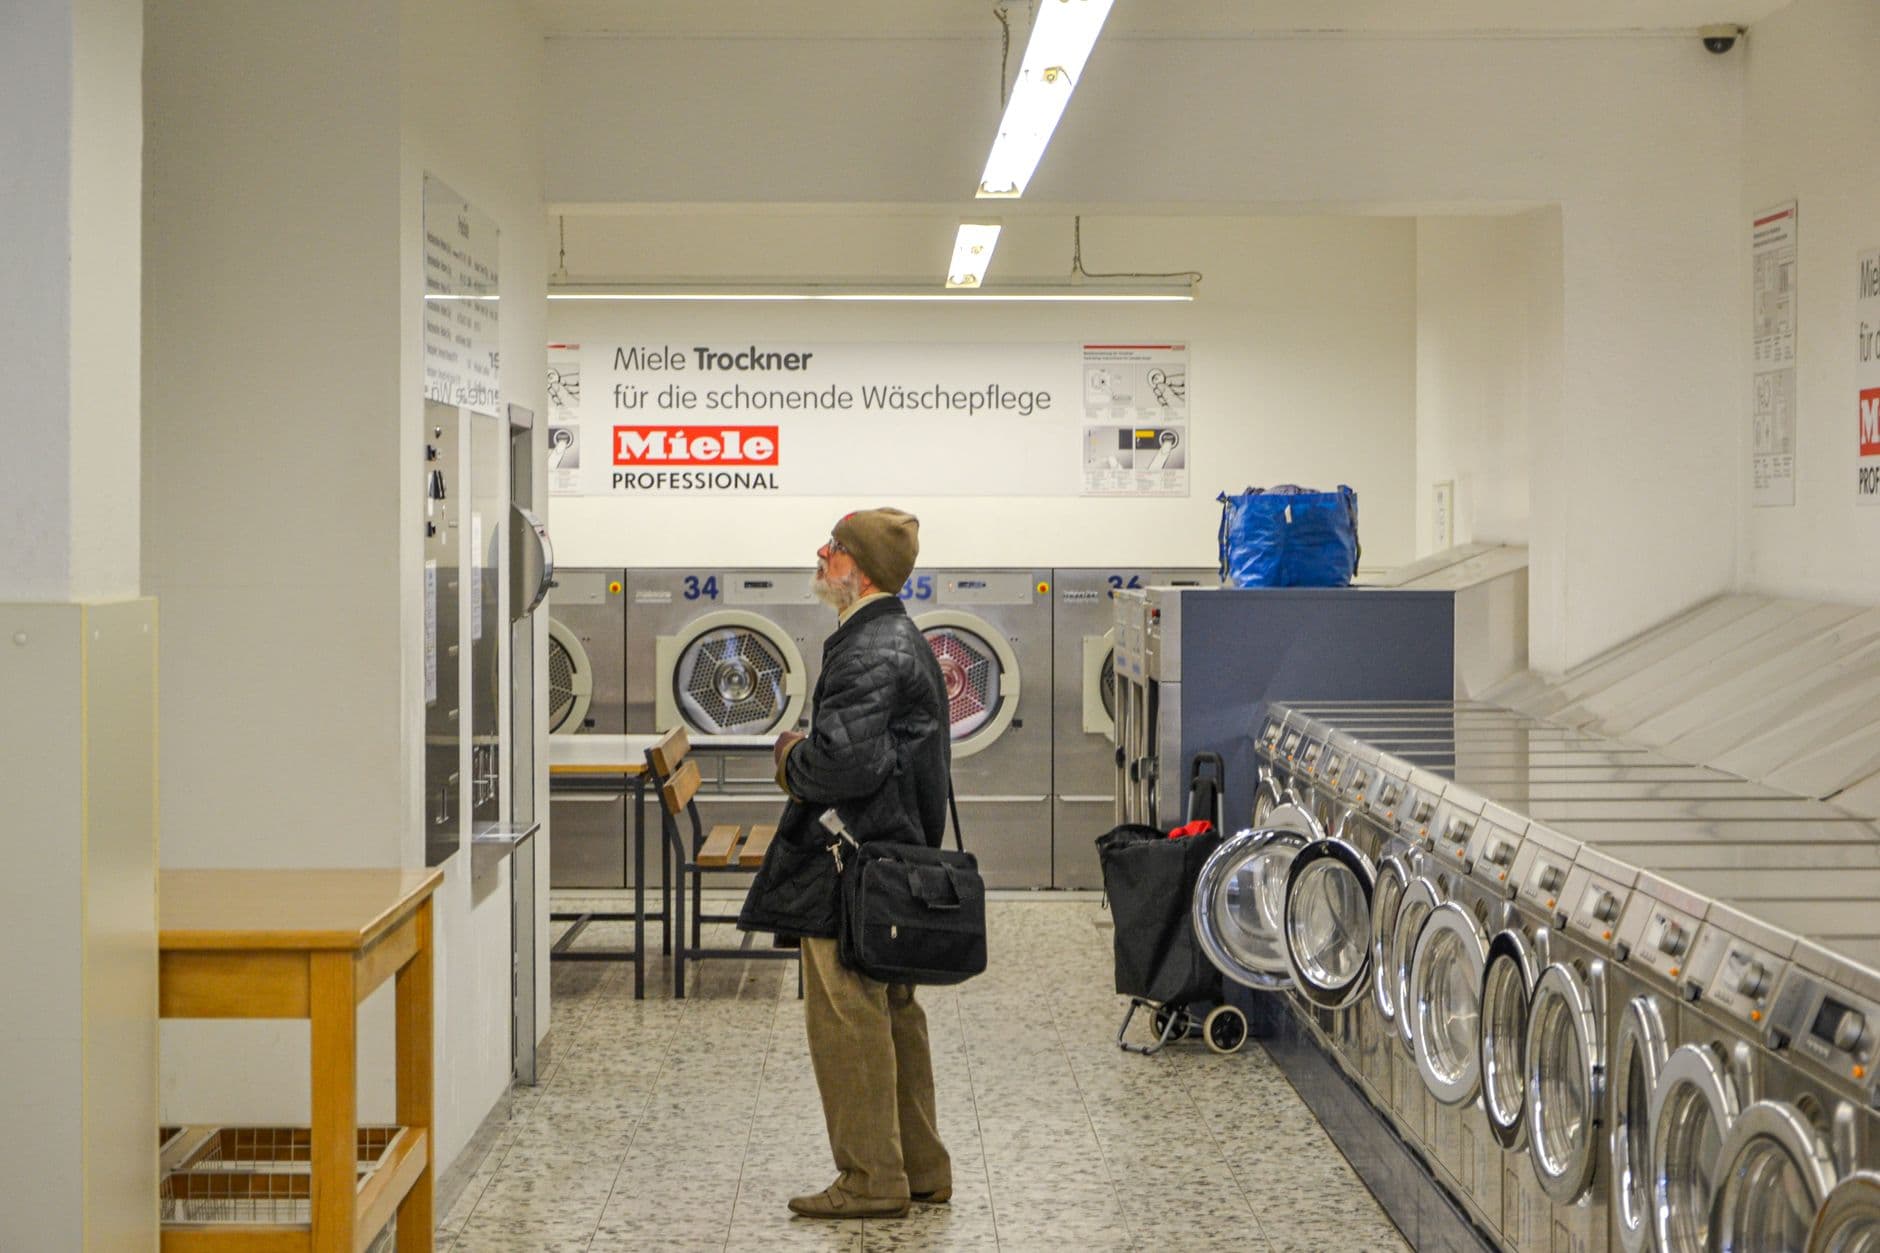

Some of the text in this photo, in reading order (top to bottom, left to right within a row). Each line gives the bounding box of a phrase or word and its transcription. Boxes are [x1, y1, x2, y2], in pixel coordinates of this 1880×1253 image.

[1859, 322, 1874, 362] für
[613, 345, 814, 371] Miele Trockner
[612, 384, 1052, 418] für die schonende Wäschepflege
[617, 430, 775, 461] Miele
[613, 472, 779, 490] PROFESSIONAL
[683, 575, 719, 601] 34
